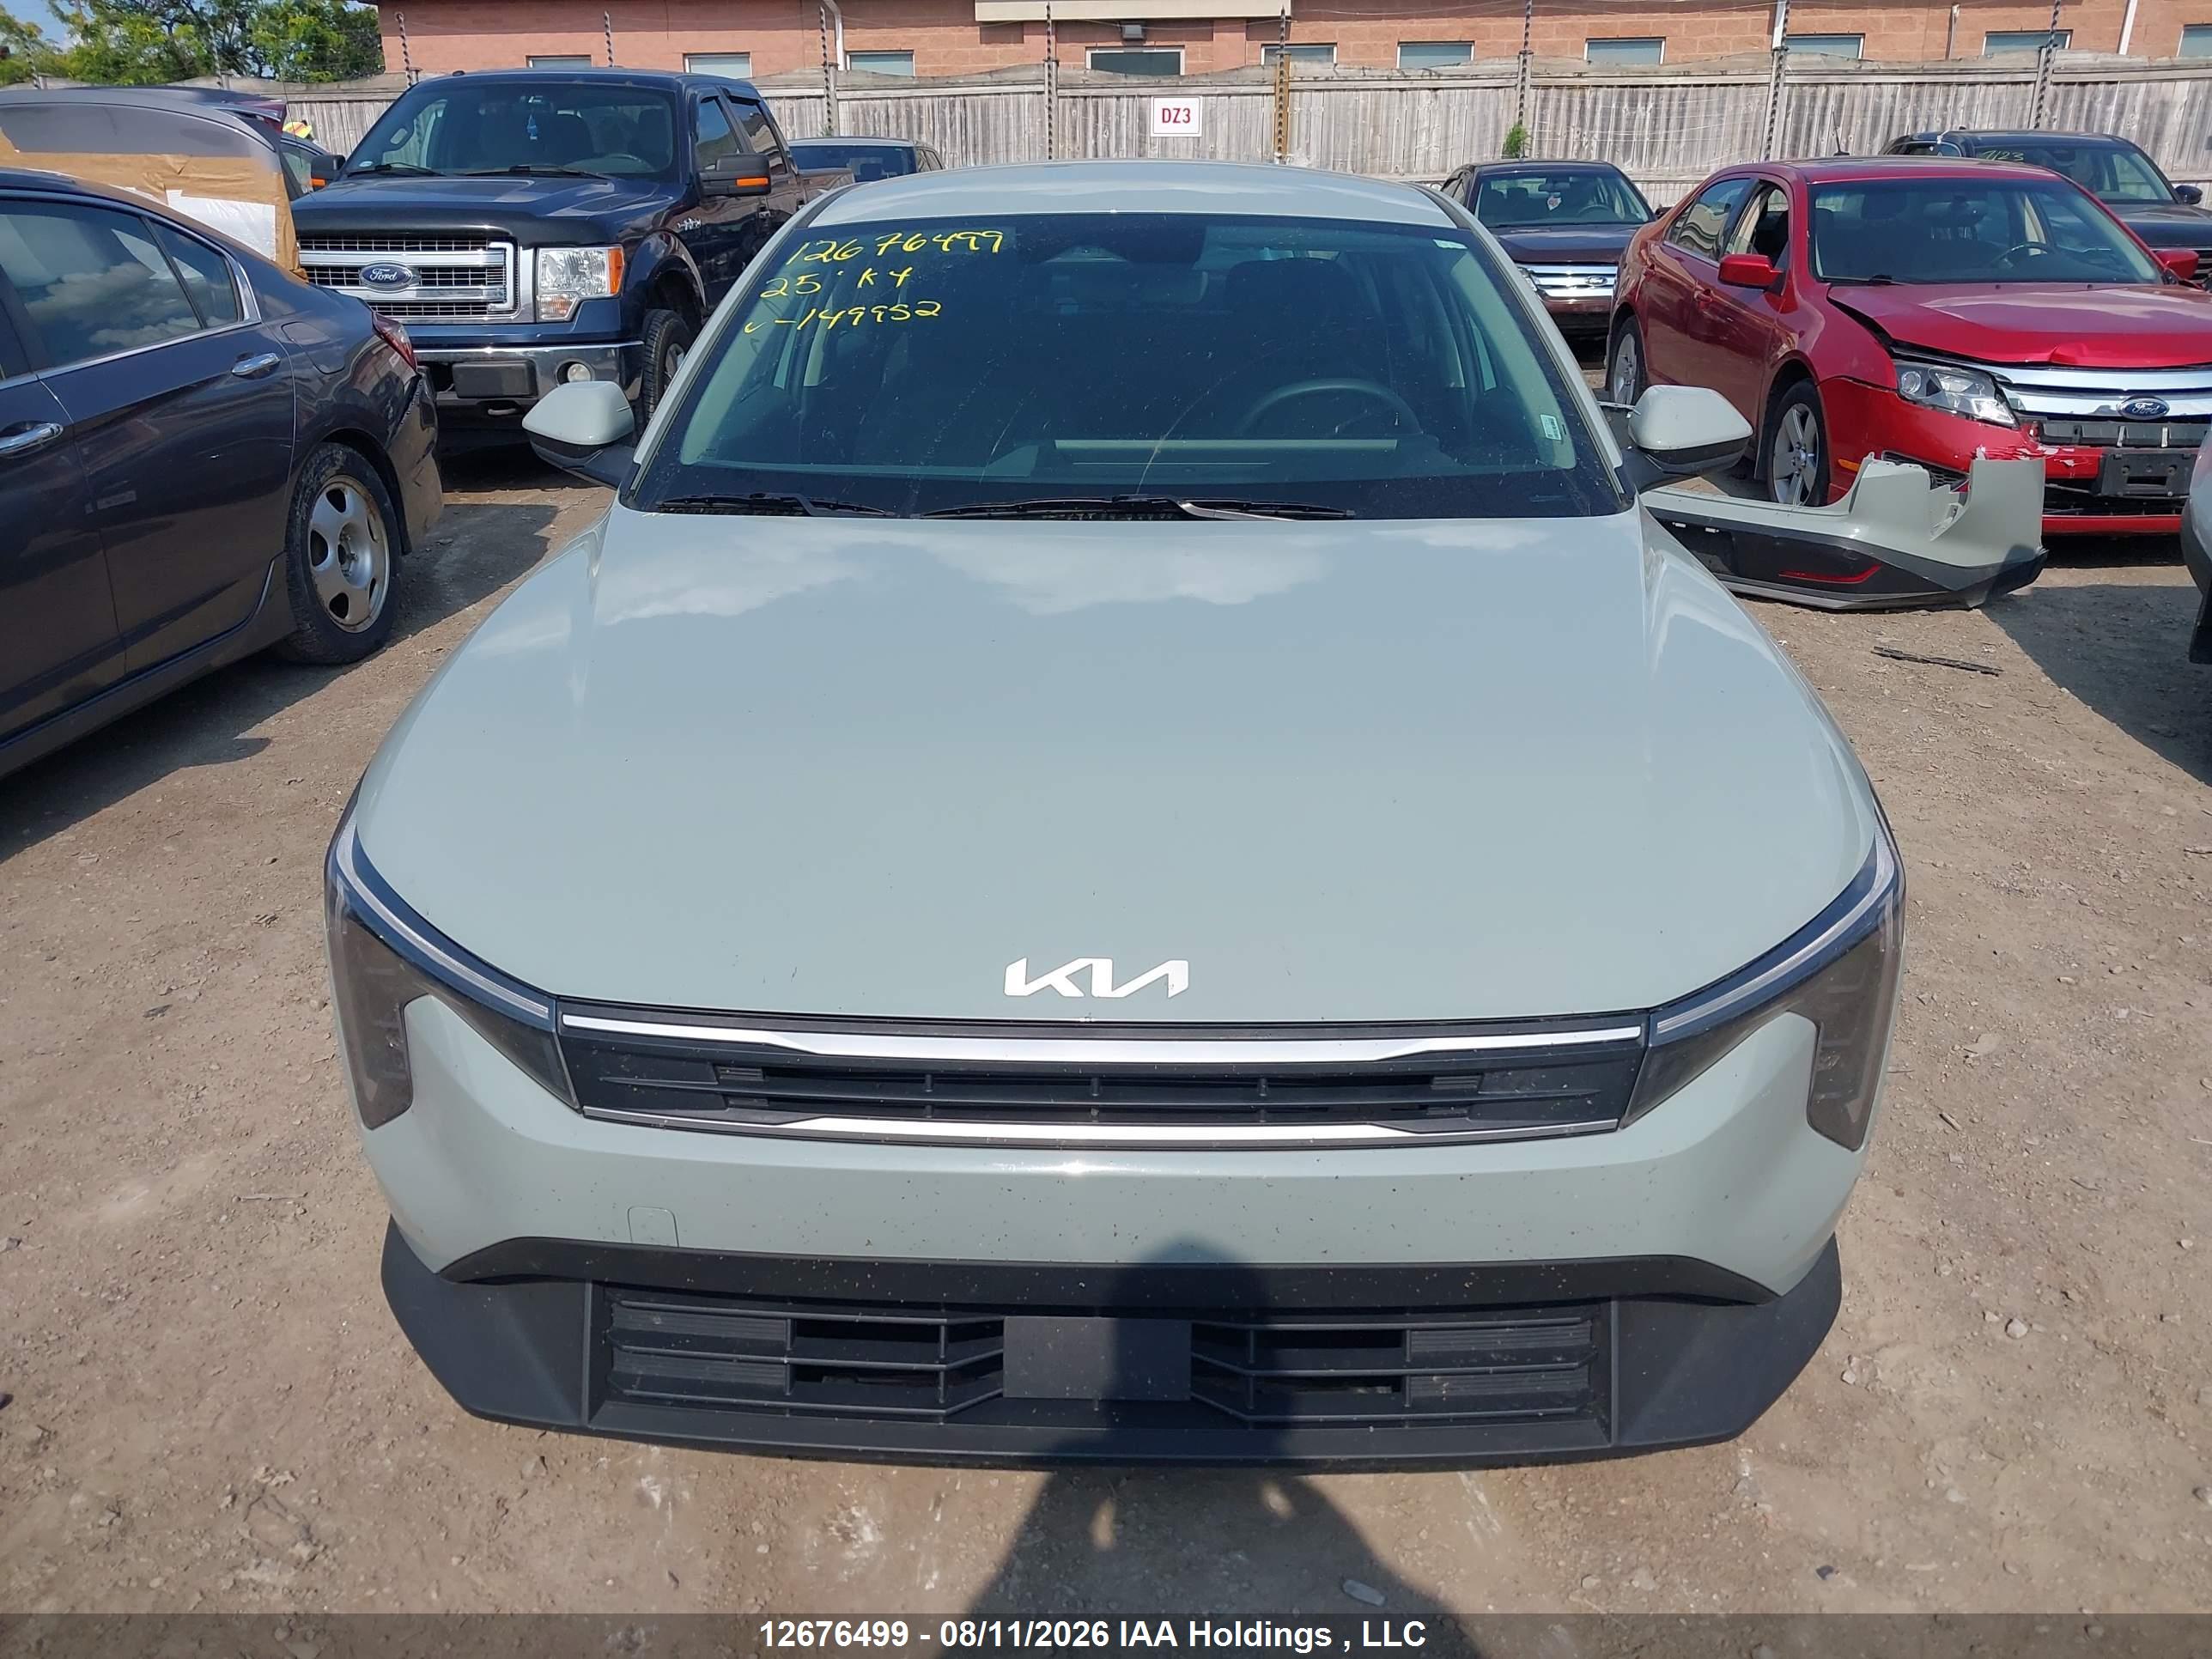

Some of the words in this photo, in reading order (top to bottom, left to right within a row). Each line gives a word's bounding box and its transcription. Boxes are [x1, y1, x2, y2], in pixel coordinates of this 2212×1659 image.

[1161, 107, 1191, 124] DZ3
[369, 268, 398, 282] Ford
[2131, 402, 2160, 414] Ford
